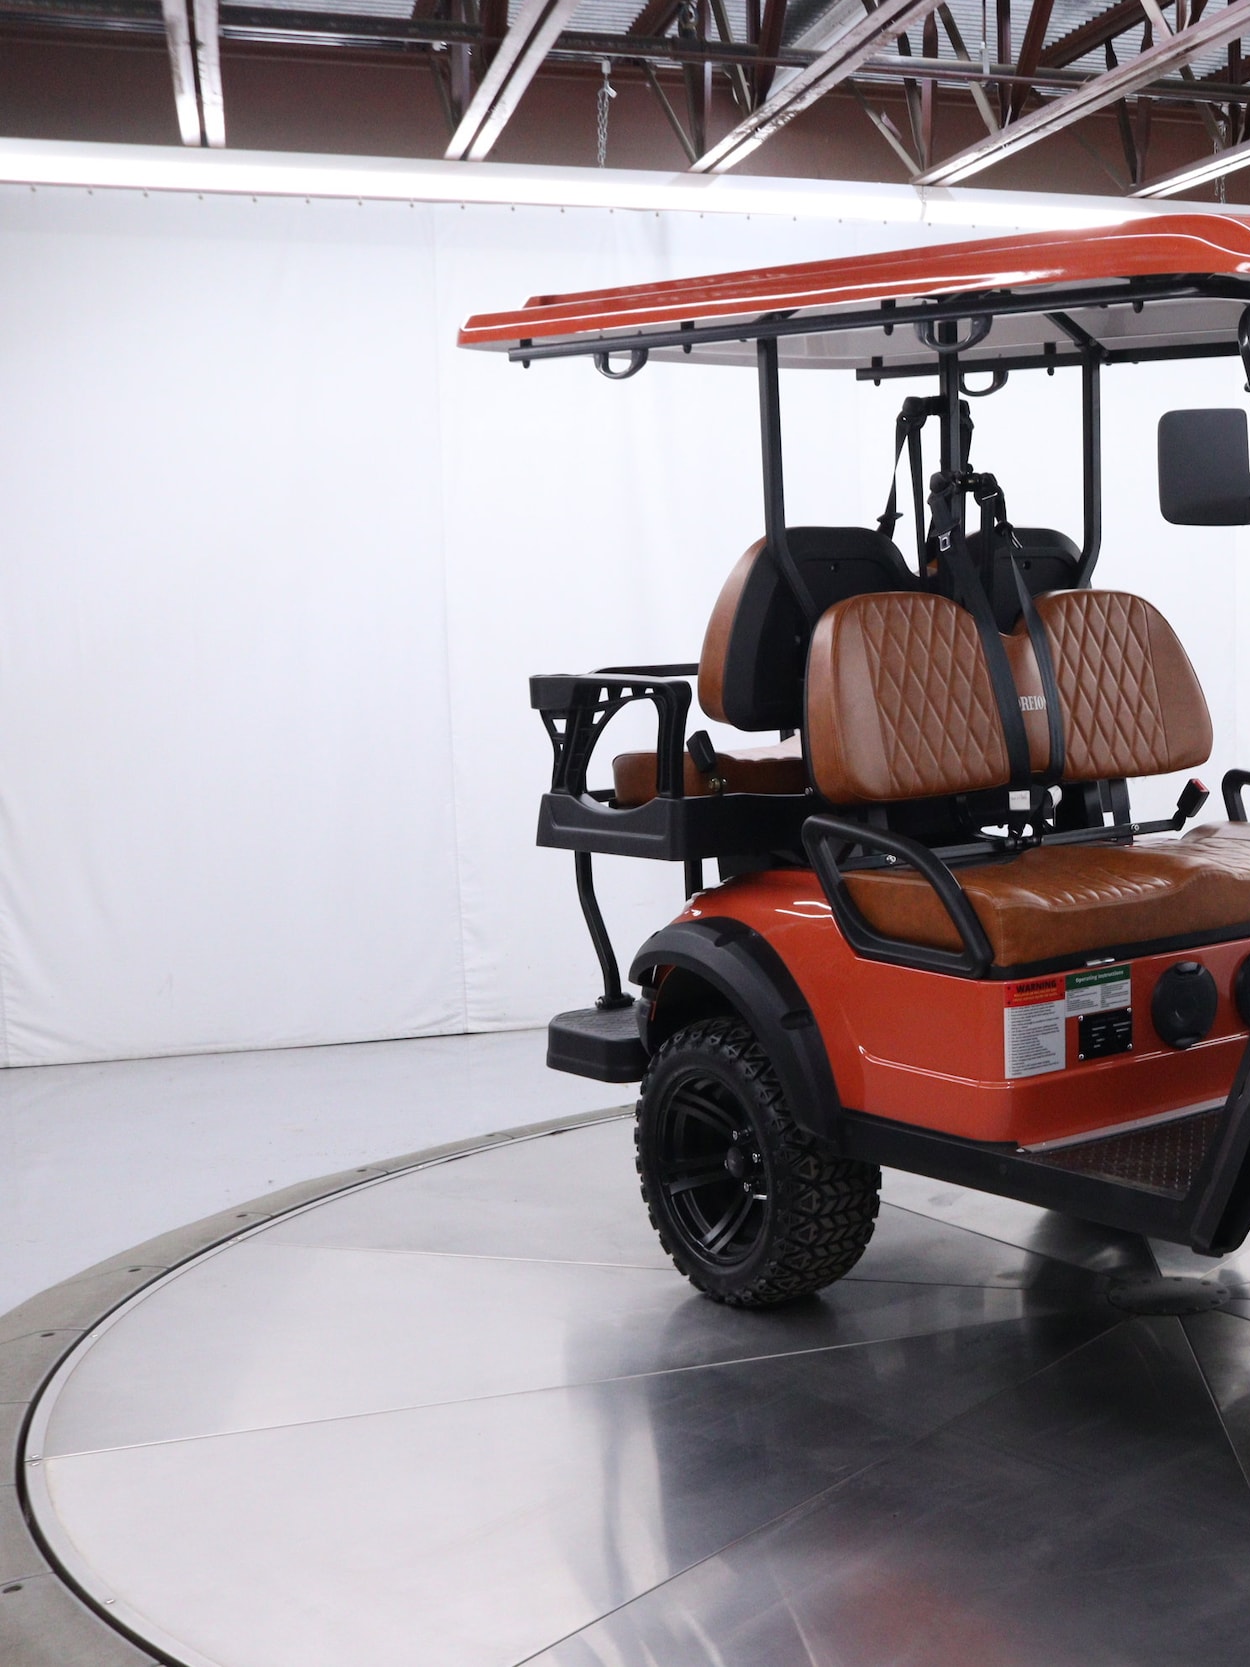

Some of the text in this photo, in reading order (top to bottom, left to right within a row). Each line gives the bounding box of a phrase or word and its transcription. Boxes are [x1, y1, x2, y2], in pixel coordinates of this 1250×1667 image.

[1018, 695, 1047, 712] REIO
[1016, 979, 1057, 993] WARNING
[1075, 975, 1098, 984] Operating
